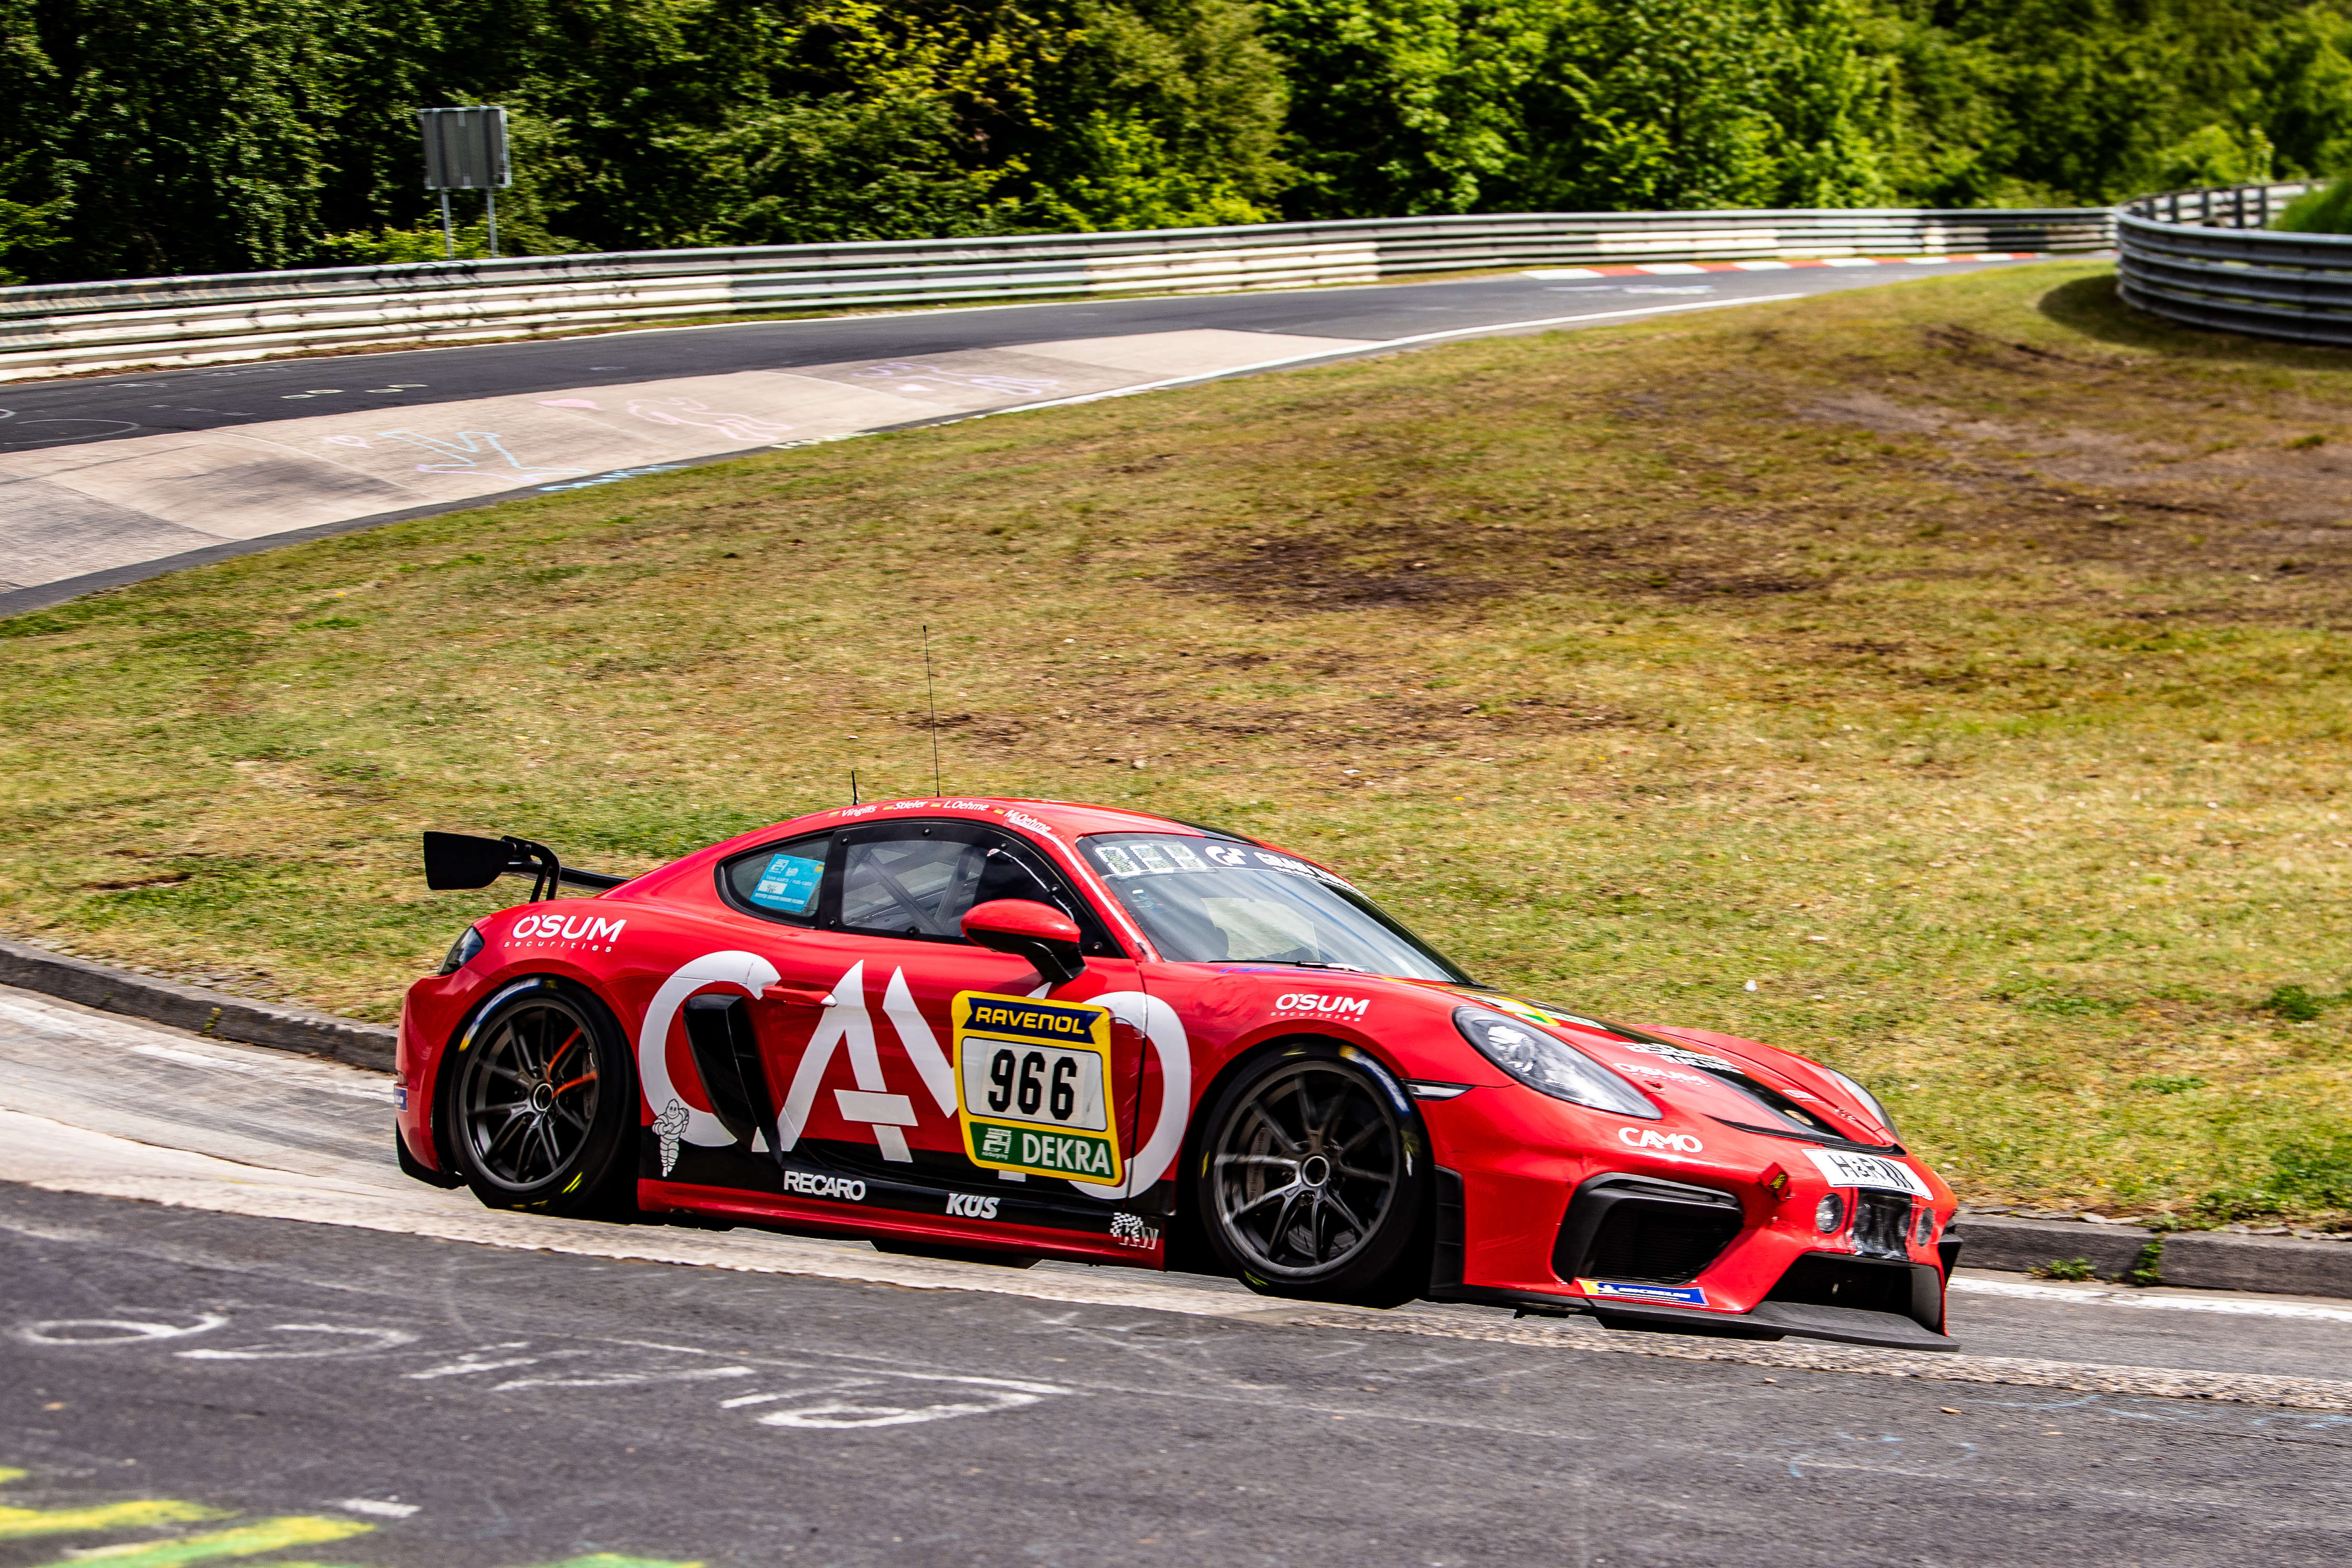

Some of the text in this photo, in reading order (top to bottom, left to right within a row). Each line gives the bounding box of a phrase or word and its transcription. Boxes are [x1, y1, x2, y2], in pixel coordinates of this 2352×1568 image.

[841, 805, 877, 817] Vingilis
[504, 941, 612, 953] securities
[975, 1007, 1085, 1035] RAVENOL
[988, 1048, 1078, 1121] 966
[1022, 1133, 1111, 1175] DEKRA
[783, 1171, 866, 1201] RECARO
[945, 1193, 1001, 1219] KÜS
